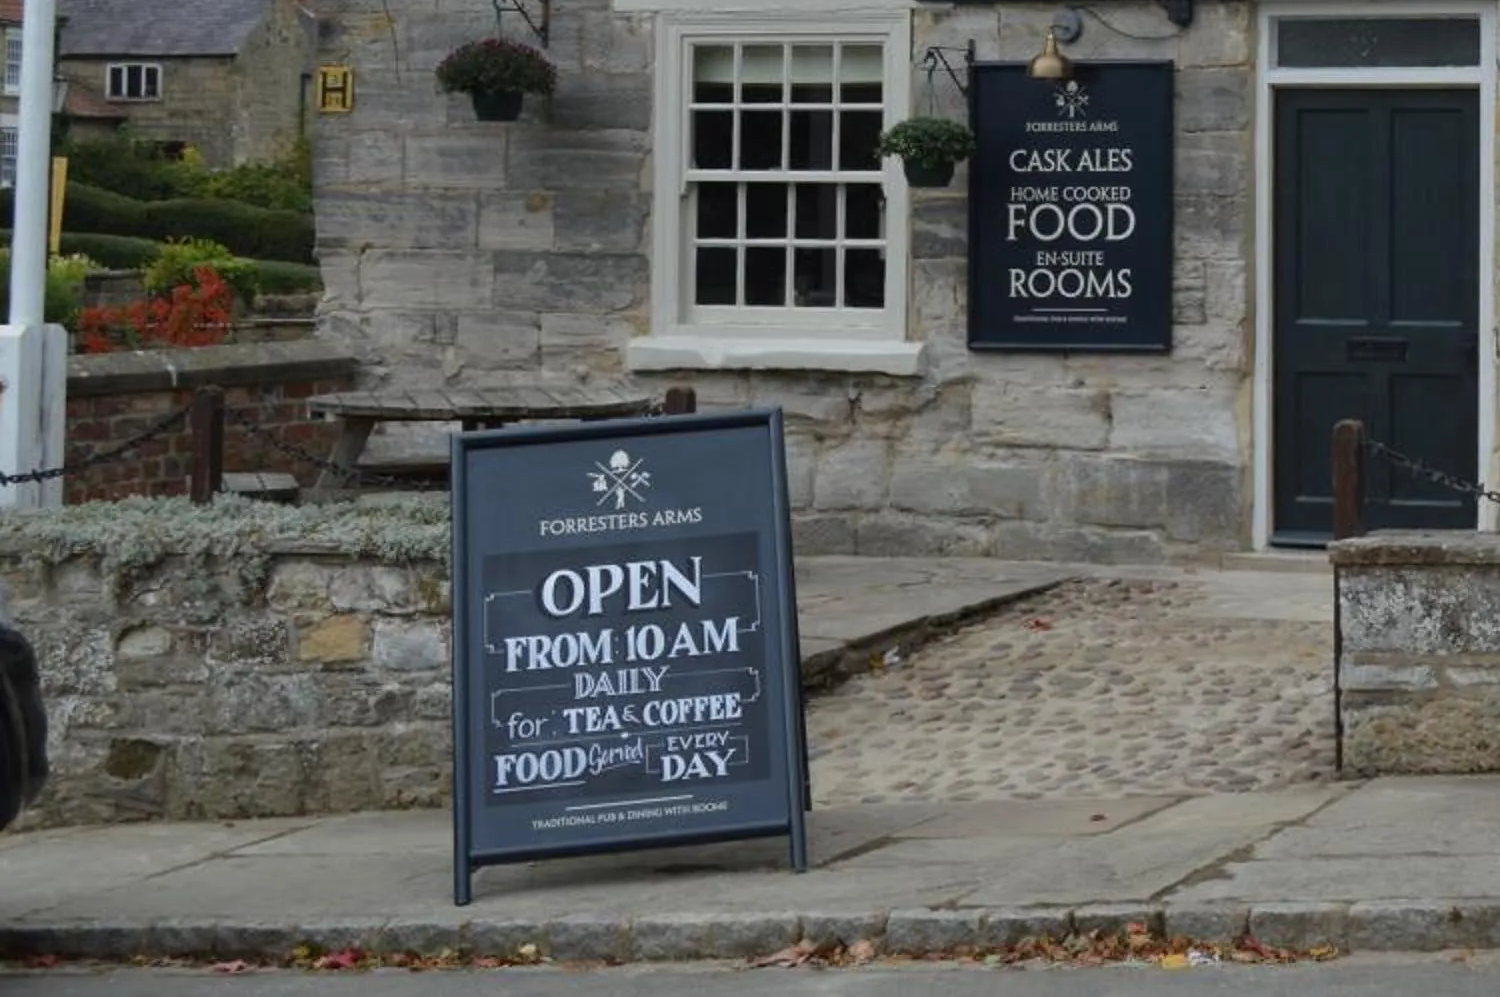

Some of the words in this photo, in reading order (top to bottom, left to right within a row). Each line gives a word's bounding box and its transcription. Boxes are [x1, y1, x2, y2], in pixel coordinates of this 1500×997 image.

[322, 71, 347, 108] H
[1009, 148, 1073, 172] CASK
[1076, 148, 1133, 172] ALES
[1011, 186, 1059, 202] HOME
[1062, 186, 1131, 202] COOKED
[1008, 203, 1135, 240] FOOD
[1009, 268, 1132, 298] ROOMS
[540, 511, 649, 536] FORRESTERS
[651, 507, 703, 526] ARMS
[543, 557, 701, 615] OPEN
[504, 629, 612, 673] FROM
[575, 666, 669, 699] DAILY
[562, 705, 622, 734] TEA
[621, 704, 641, 724] &
[642, 693, 742, 726] COFFEE
[666, 729, 731, 754] EVERY
[494, 747, 587, 785] FOOD
[660, 749, 737, 782] DAY
